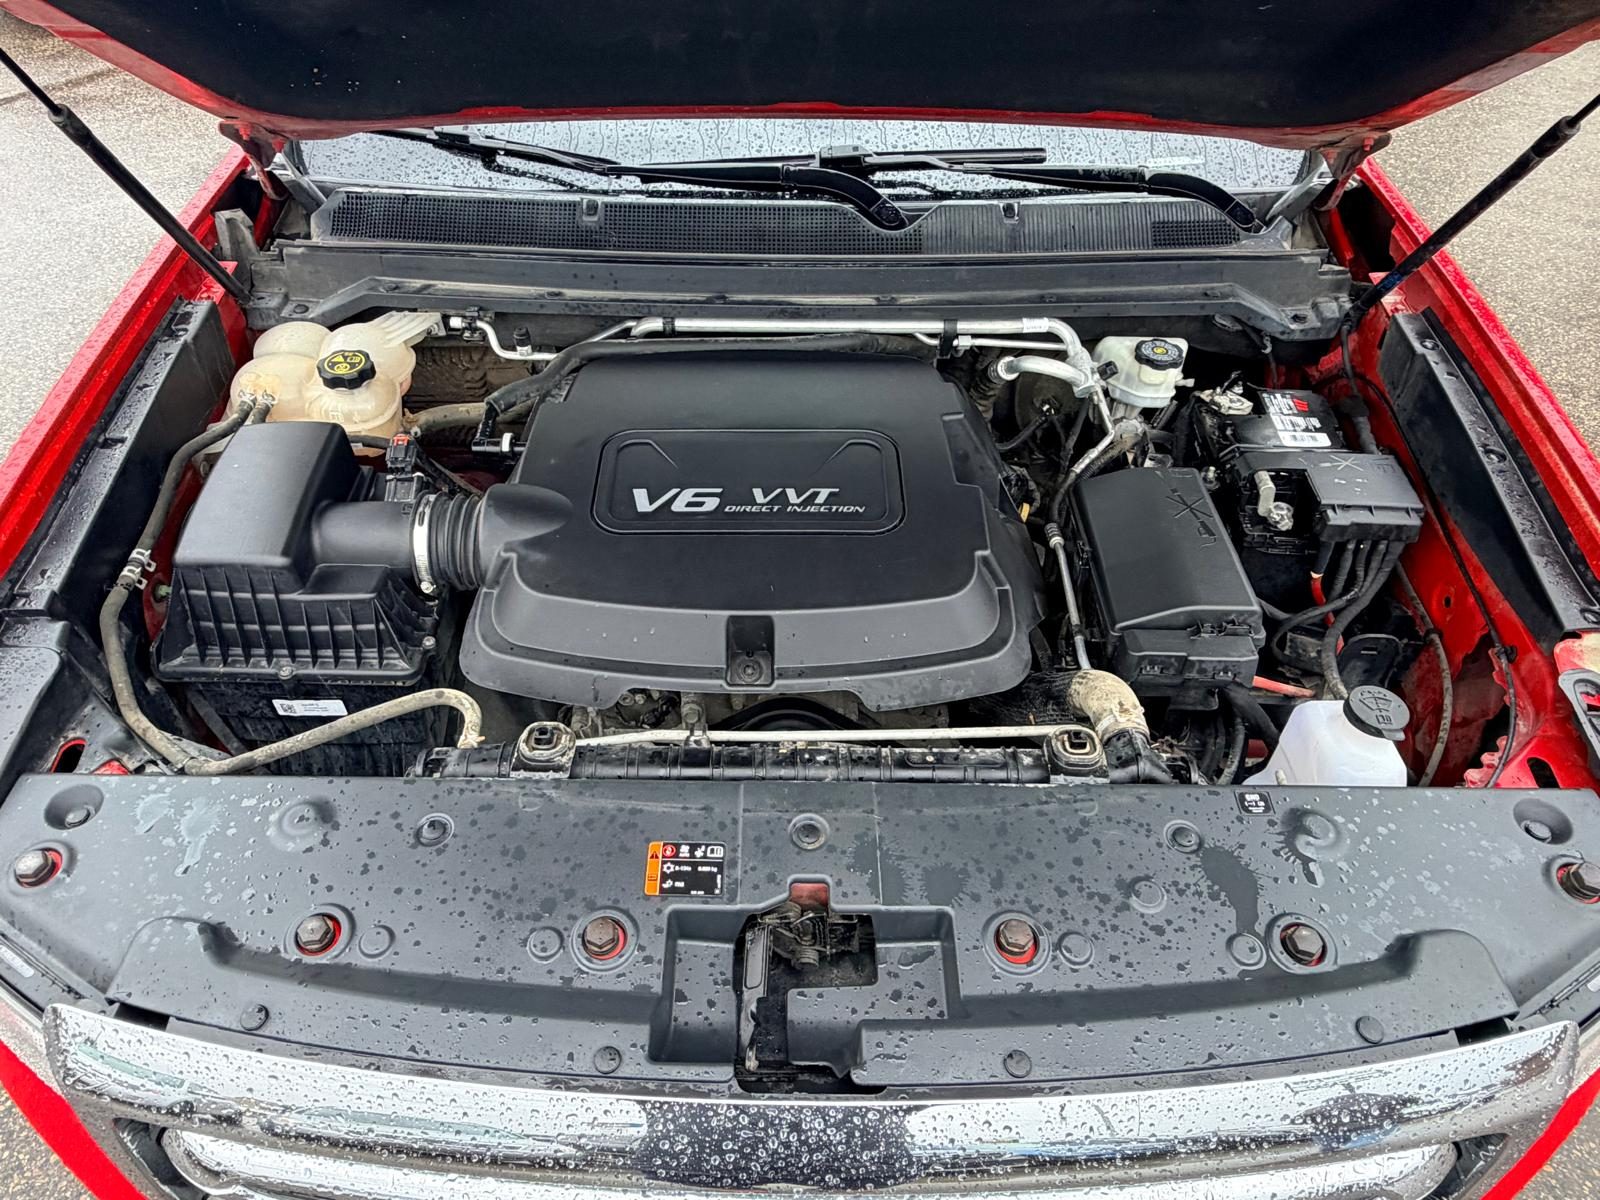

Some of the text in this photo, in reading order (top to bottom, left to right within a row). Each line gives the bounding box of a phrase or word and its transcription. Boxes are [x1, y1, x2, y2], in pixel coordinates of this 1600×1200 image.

[632, 487, 724, 513] V6
[751, 487, 840, 504] VVT
[724, 505, 866, 513] DIRECT INJECTION
